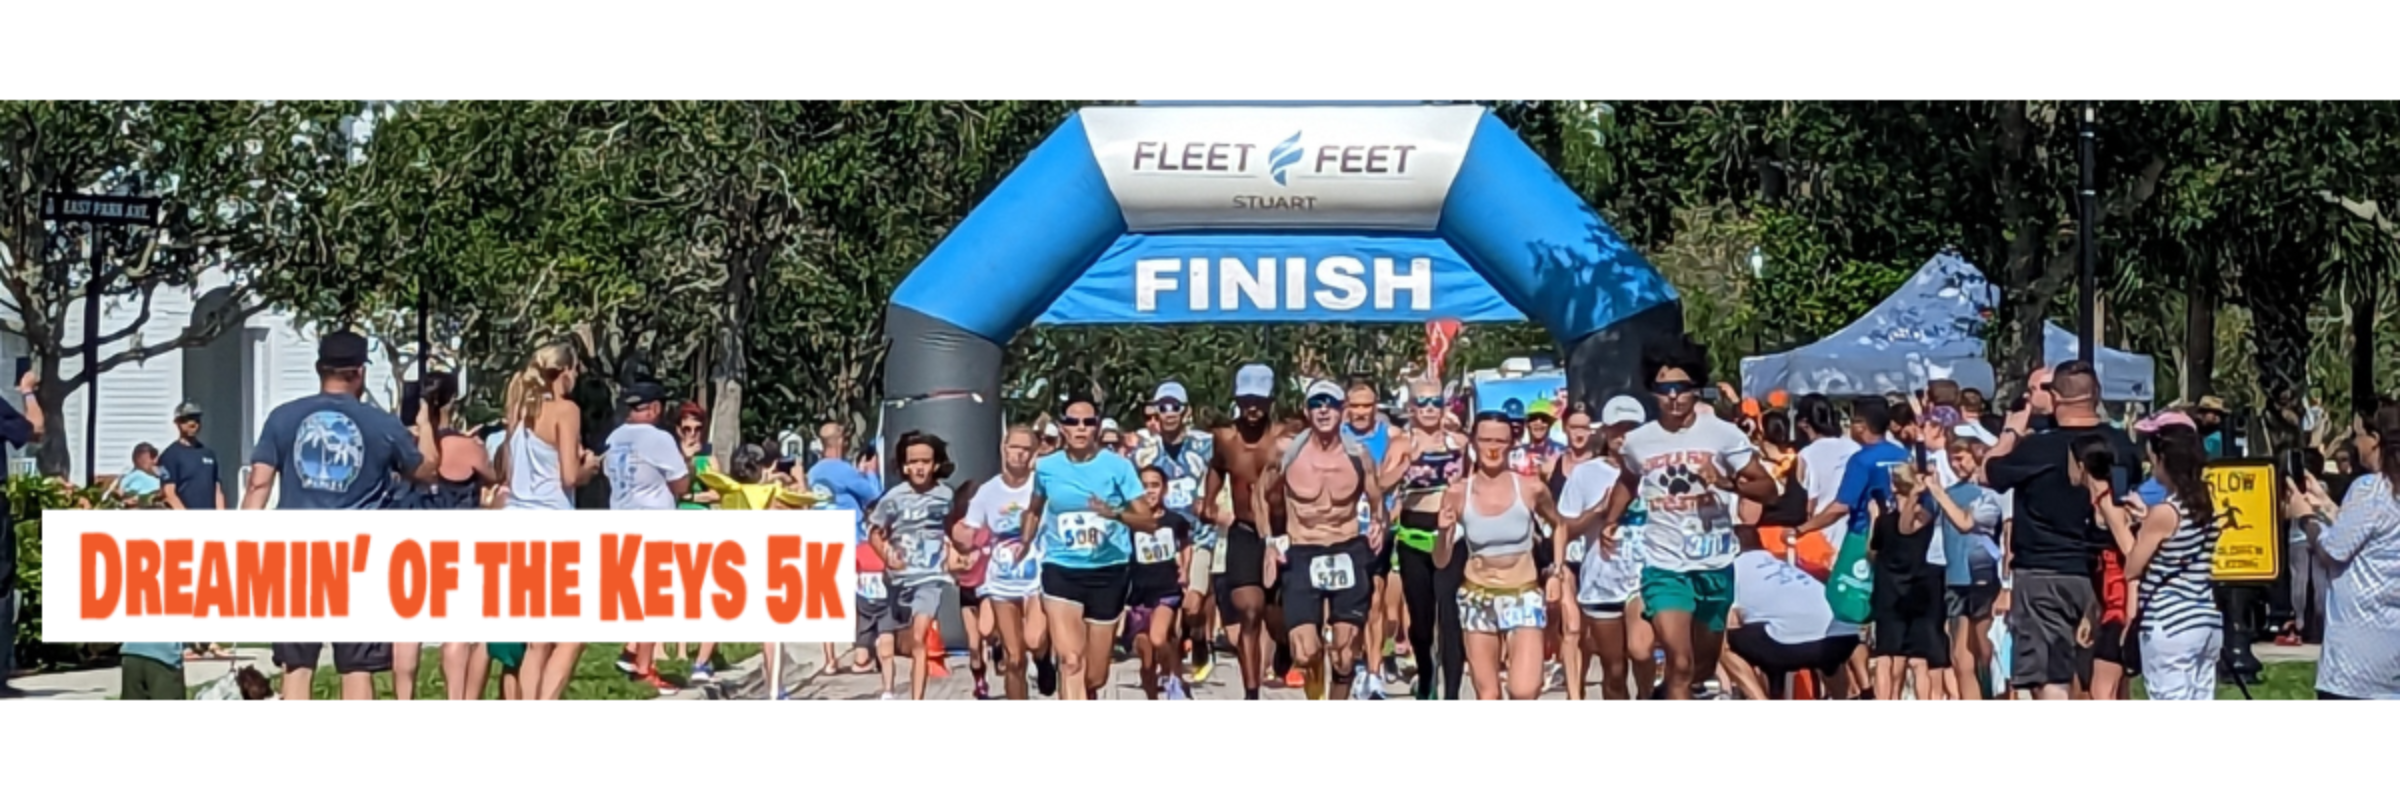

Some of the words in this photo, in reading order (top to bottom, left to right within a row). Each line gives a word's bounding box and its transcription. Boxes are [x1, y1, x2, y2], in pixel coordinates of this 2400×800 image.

[1133, 141, 1256, 173] FLEET
[1315, 145, 1416, 174] FEET
[63, 199, 92, 214] EAST
[94, 201, 123, 217] PARK
[1232, 195, 1317, 211] STUART
[1136, 256, 1432, 312] FINISH
